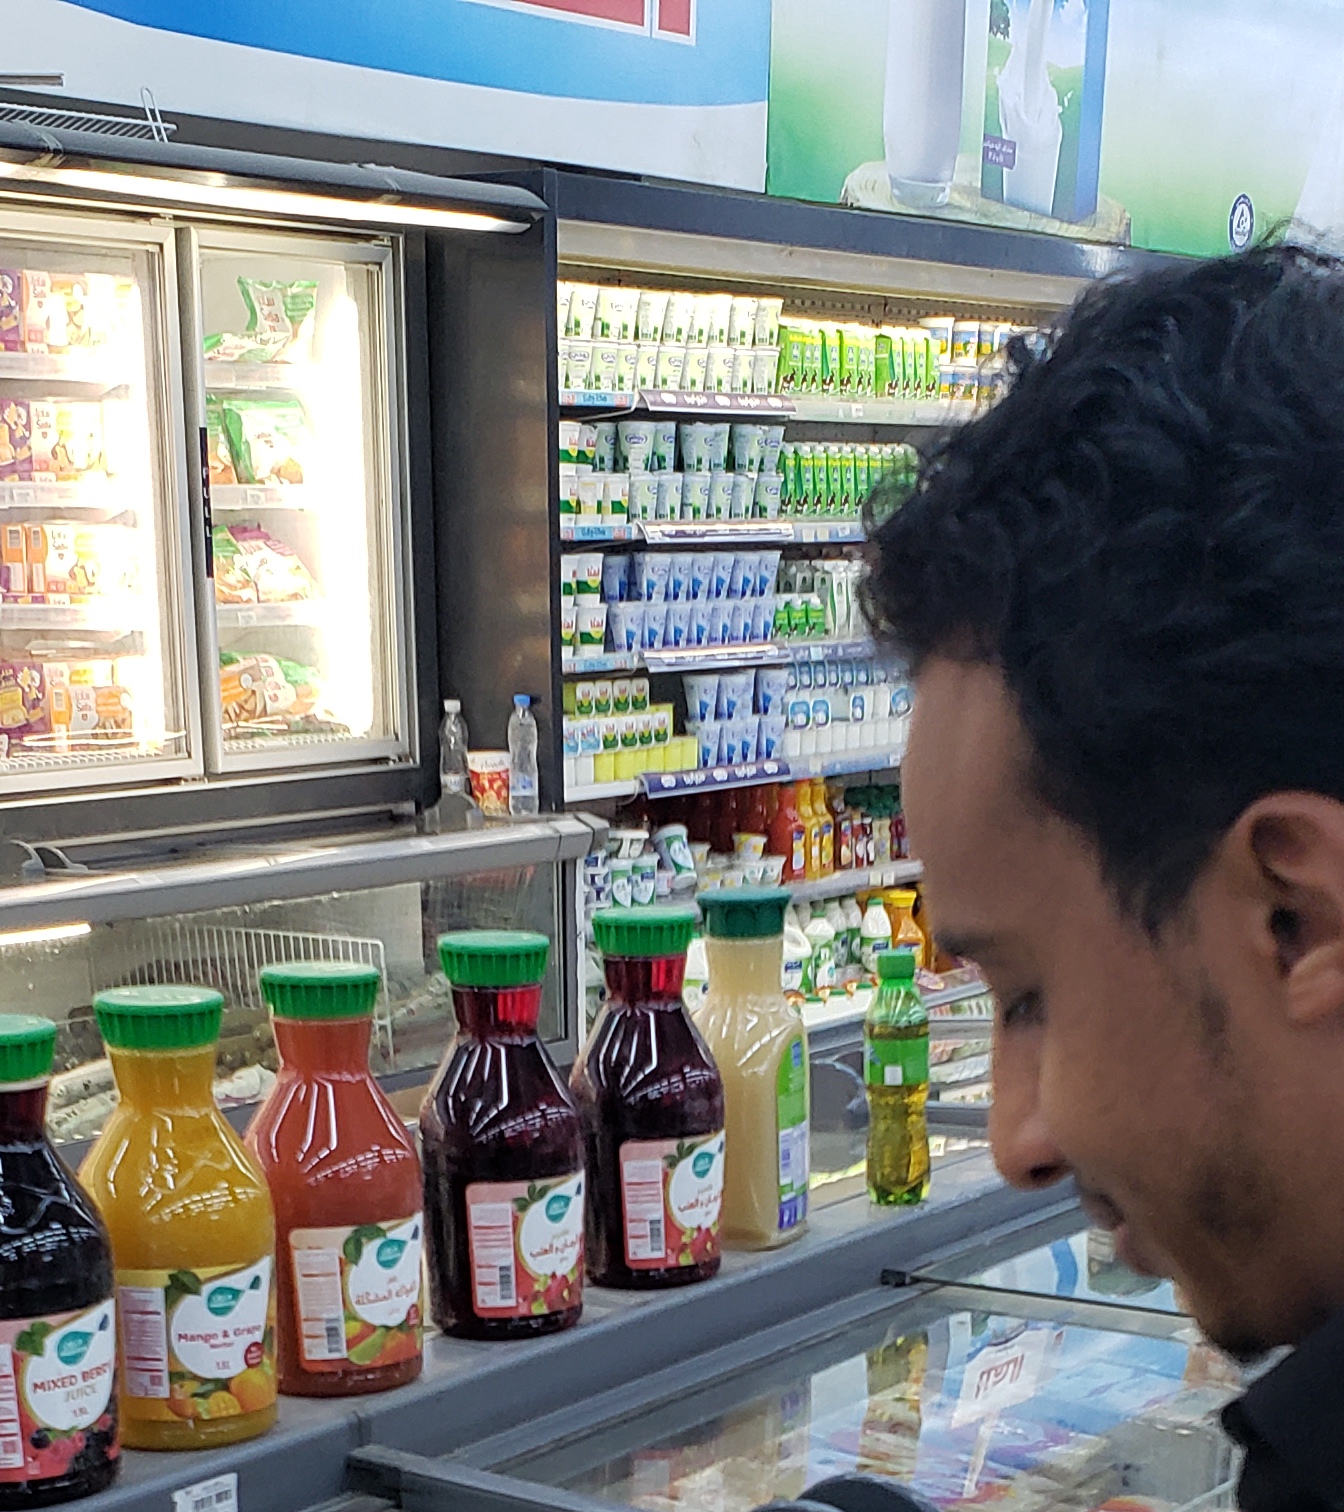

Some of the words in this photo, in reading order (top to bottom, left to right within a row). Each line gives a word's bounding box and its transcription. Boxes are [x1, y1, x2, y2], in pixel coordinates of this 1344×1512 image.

[201, 467, 212, 538] PULL
[178, 1329, 218, 1345] Mango
[33, 1374, 77, 1394] MIXED
[64, 1384, 98, 1402] JUICE
